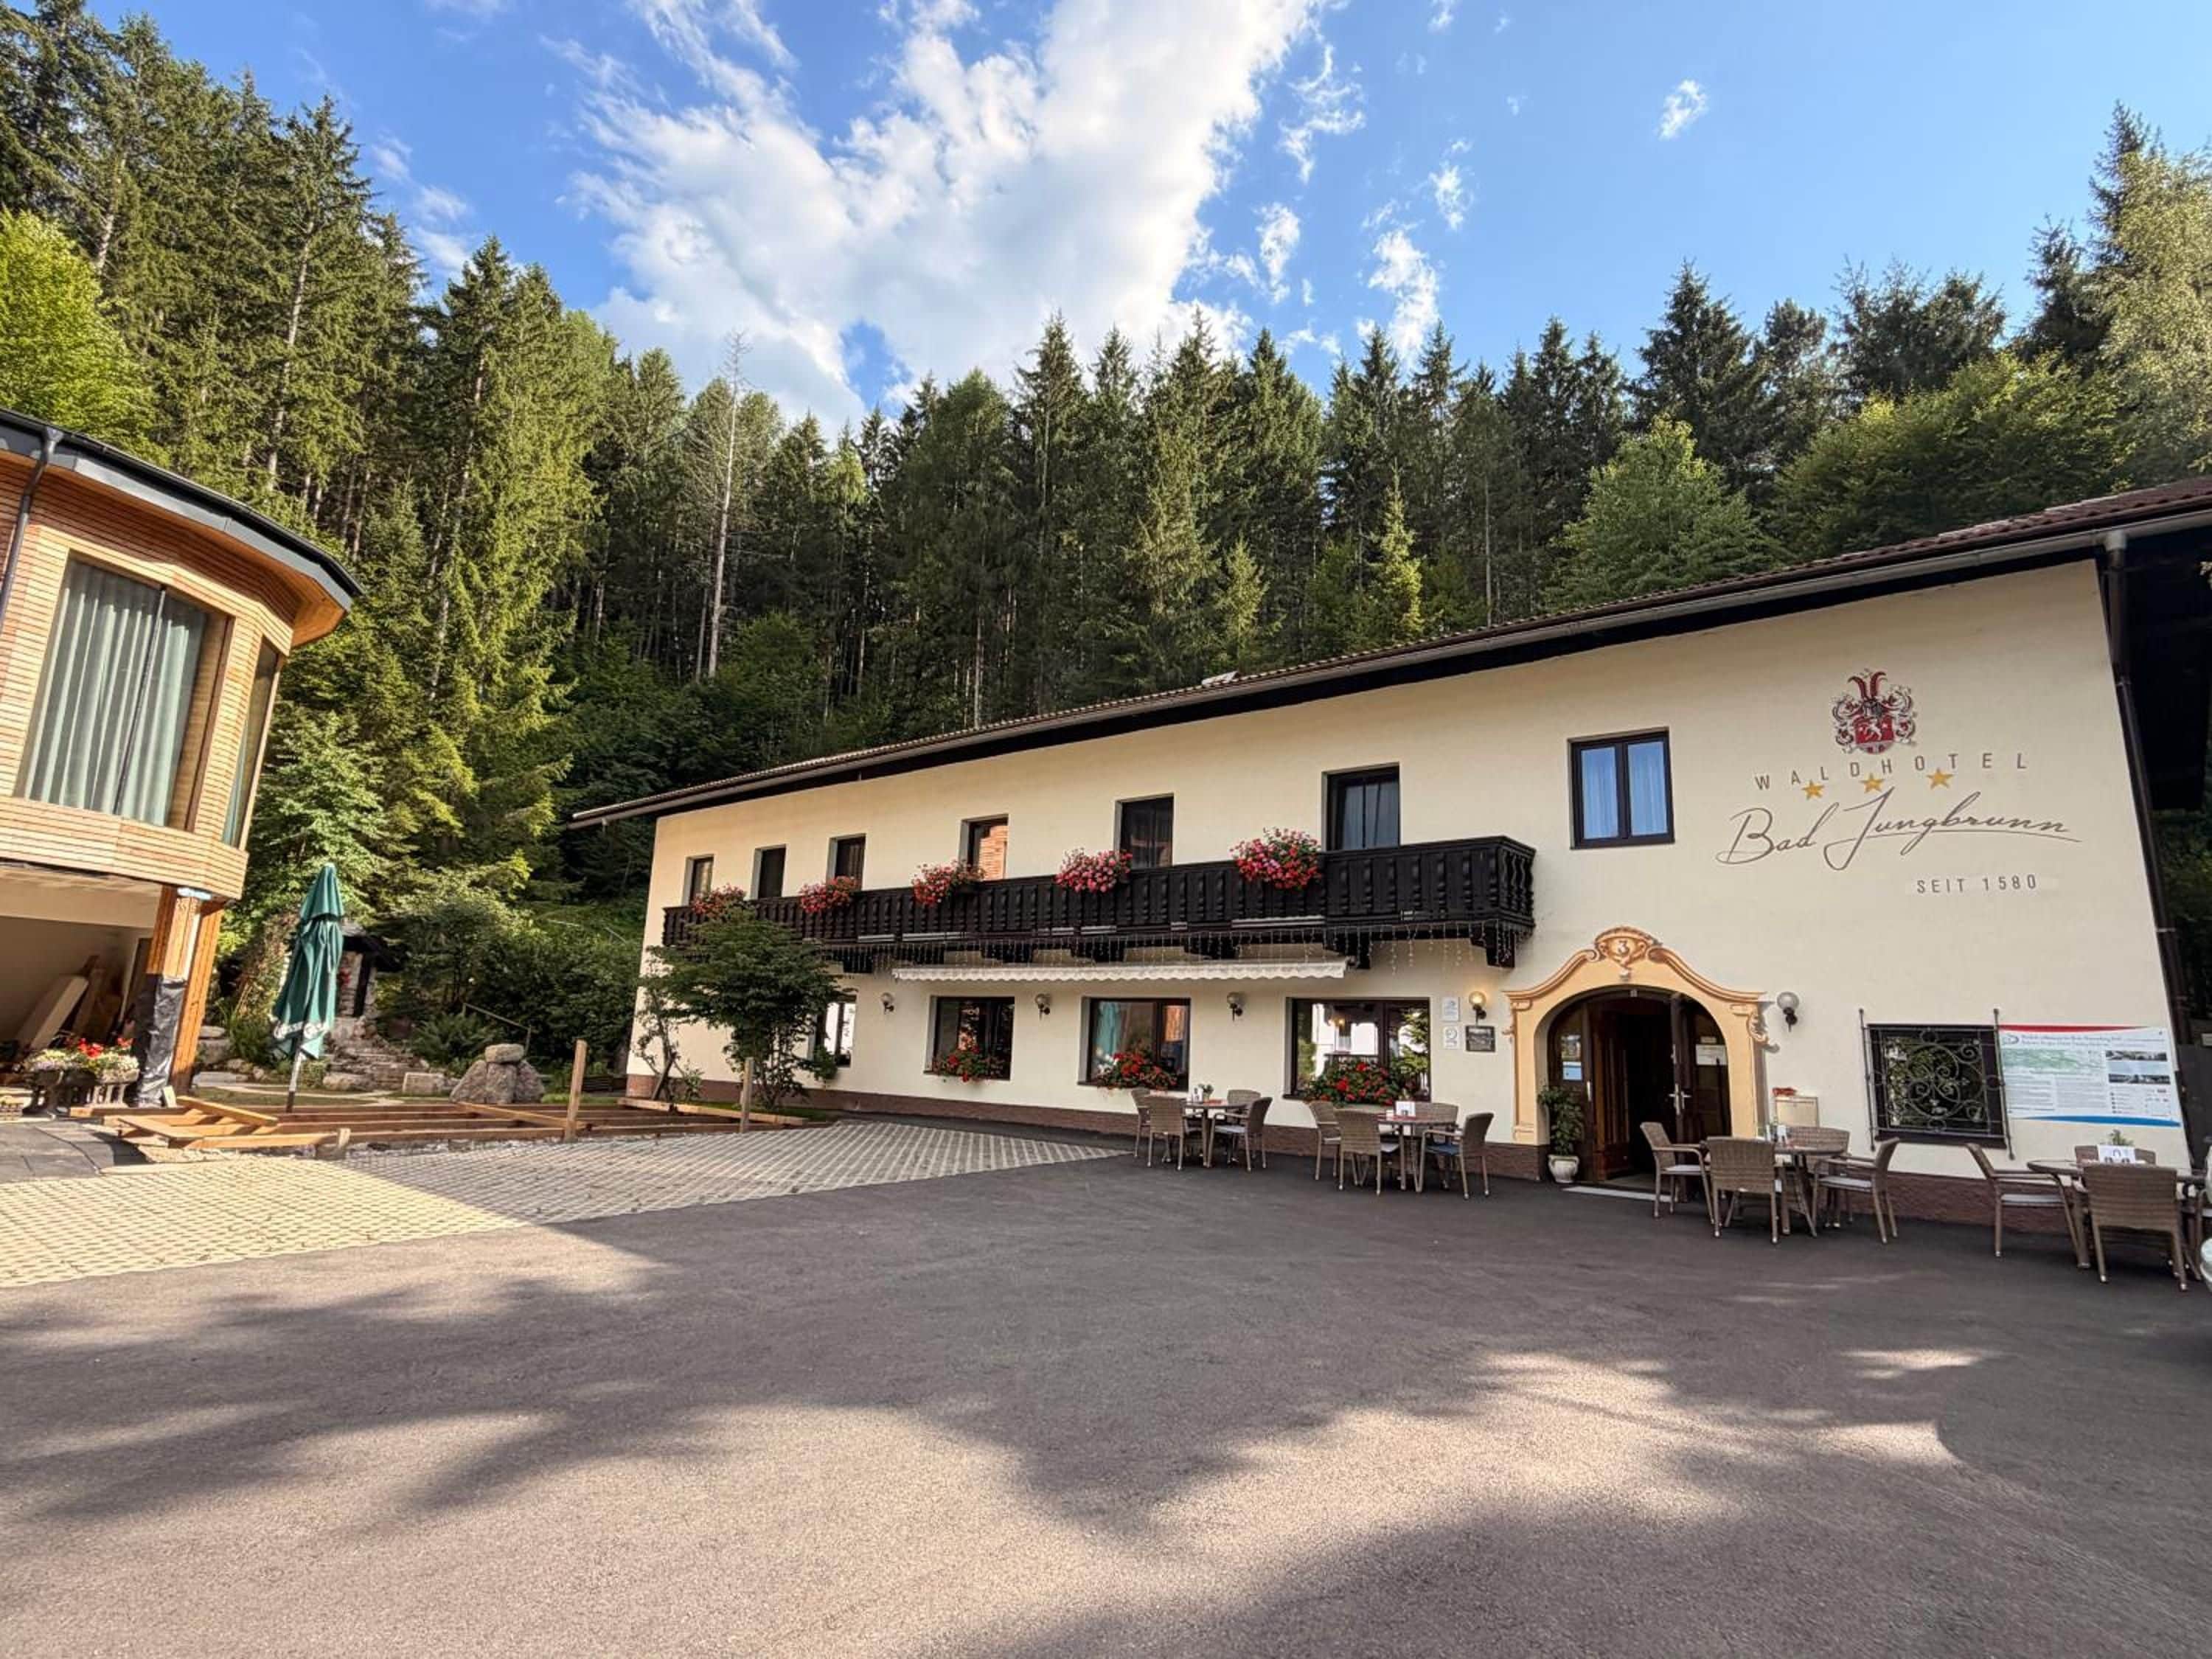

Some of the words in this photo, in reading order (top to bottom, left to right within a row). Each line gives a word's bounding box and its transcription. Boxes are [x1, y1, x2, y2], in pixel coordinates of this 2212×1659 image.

[1754, 752, 2028, 790] WALDHOTEL
[1715, 801, 1840, 865] Bad
[1823, 786, 2081, 871] Jungbrunn
[1916, 877, 1966, 894] SEIT
[1981, 874, 2037, 891] 1580
